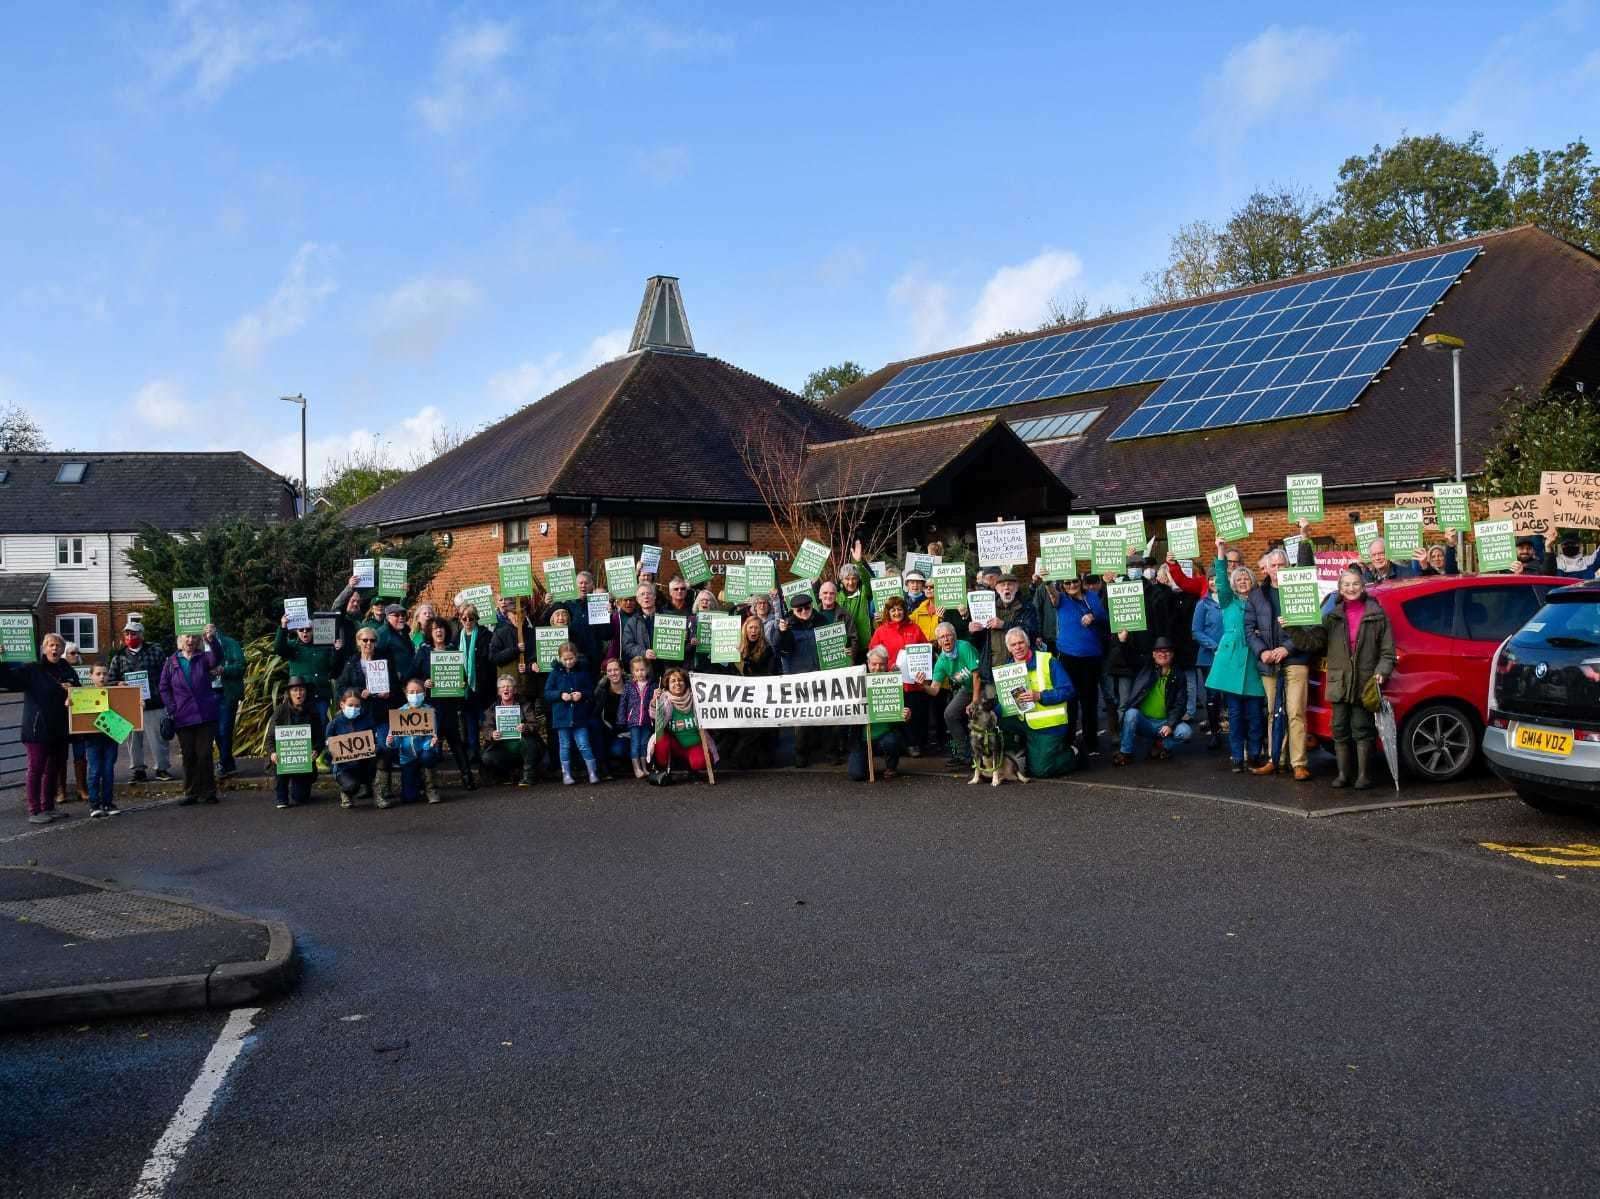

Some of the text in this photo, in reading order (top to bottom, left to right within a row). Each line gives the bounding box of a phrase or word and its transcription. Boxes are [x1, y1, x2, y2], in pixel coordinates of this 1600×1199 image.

[1546, 488, 1558, 496] TO
[1210, 491, 1234, 504] SAY NO
[1503, 500, 1538, 512] SAVE
[1217, 519, 1241, 532] HEATH
[1480, 526, 1494, 534] SAY
[1513, 519, 1548, 532] LAGES
[1483, 551, 1511, 562] HEATH
[1045, 563, 1071, 571] HEATH
[1333, 558, 1346, 566] tough
[686, 566, 706, 578] HEATH
[796, 561, 818, 574] HEATH
[1282, 572, 1312, 581] SAY NO
[550, 583, 573, 592] HEATH
[611, 582, 632, 590] HEATH
[1112, 586, 1138, 595] SAY NO
[1285, 604, 1315, 613] HEATH
[1114, 613, 1141, 623] HEATH
[819, 629, 830, 637] SAY
[822, 652, 846, 662] HEATH
[369, 662, 385, 671] NO
[997, 667, 1023, 678] SAY NO
[694, 676, 866, 704] SAVE LENHAM
[701, 702, 868, 719] ROM MORE DEVELOPMENT
[871, 703, 898, 712] HEATH
[400, 713, 428, 727] NO!
[339, 736, 372, 754] NO!
[1522, 730, 1566, 751] GM14 VDZ
[281, 756, 307, 764] HEATH
